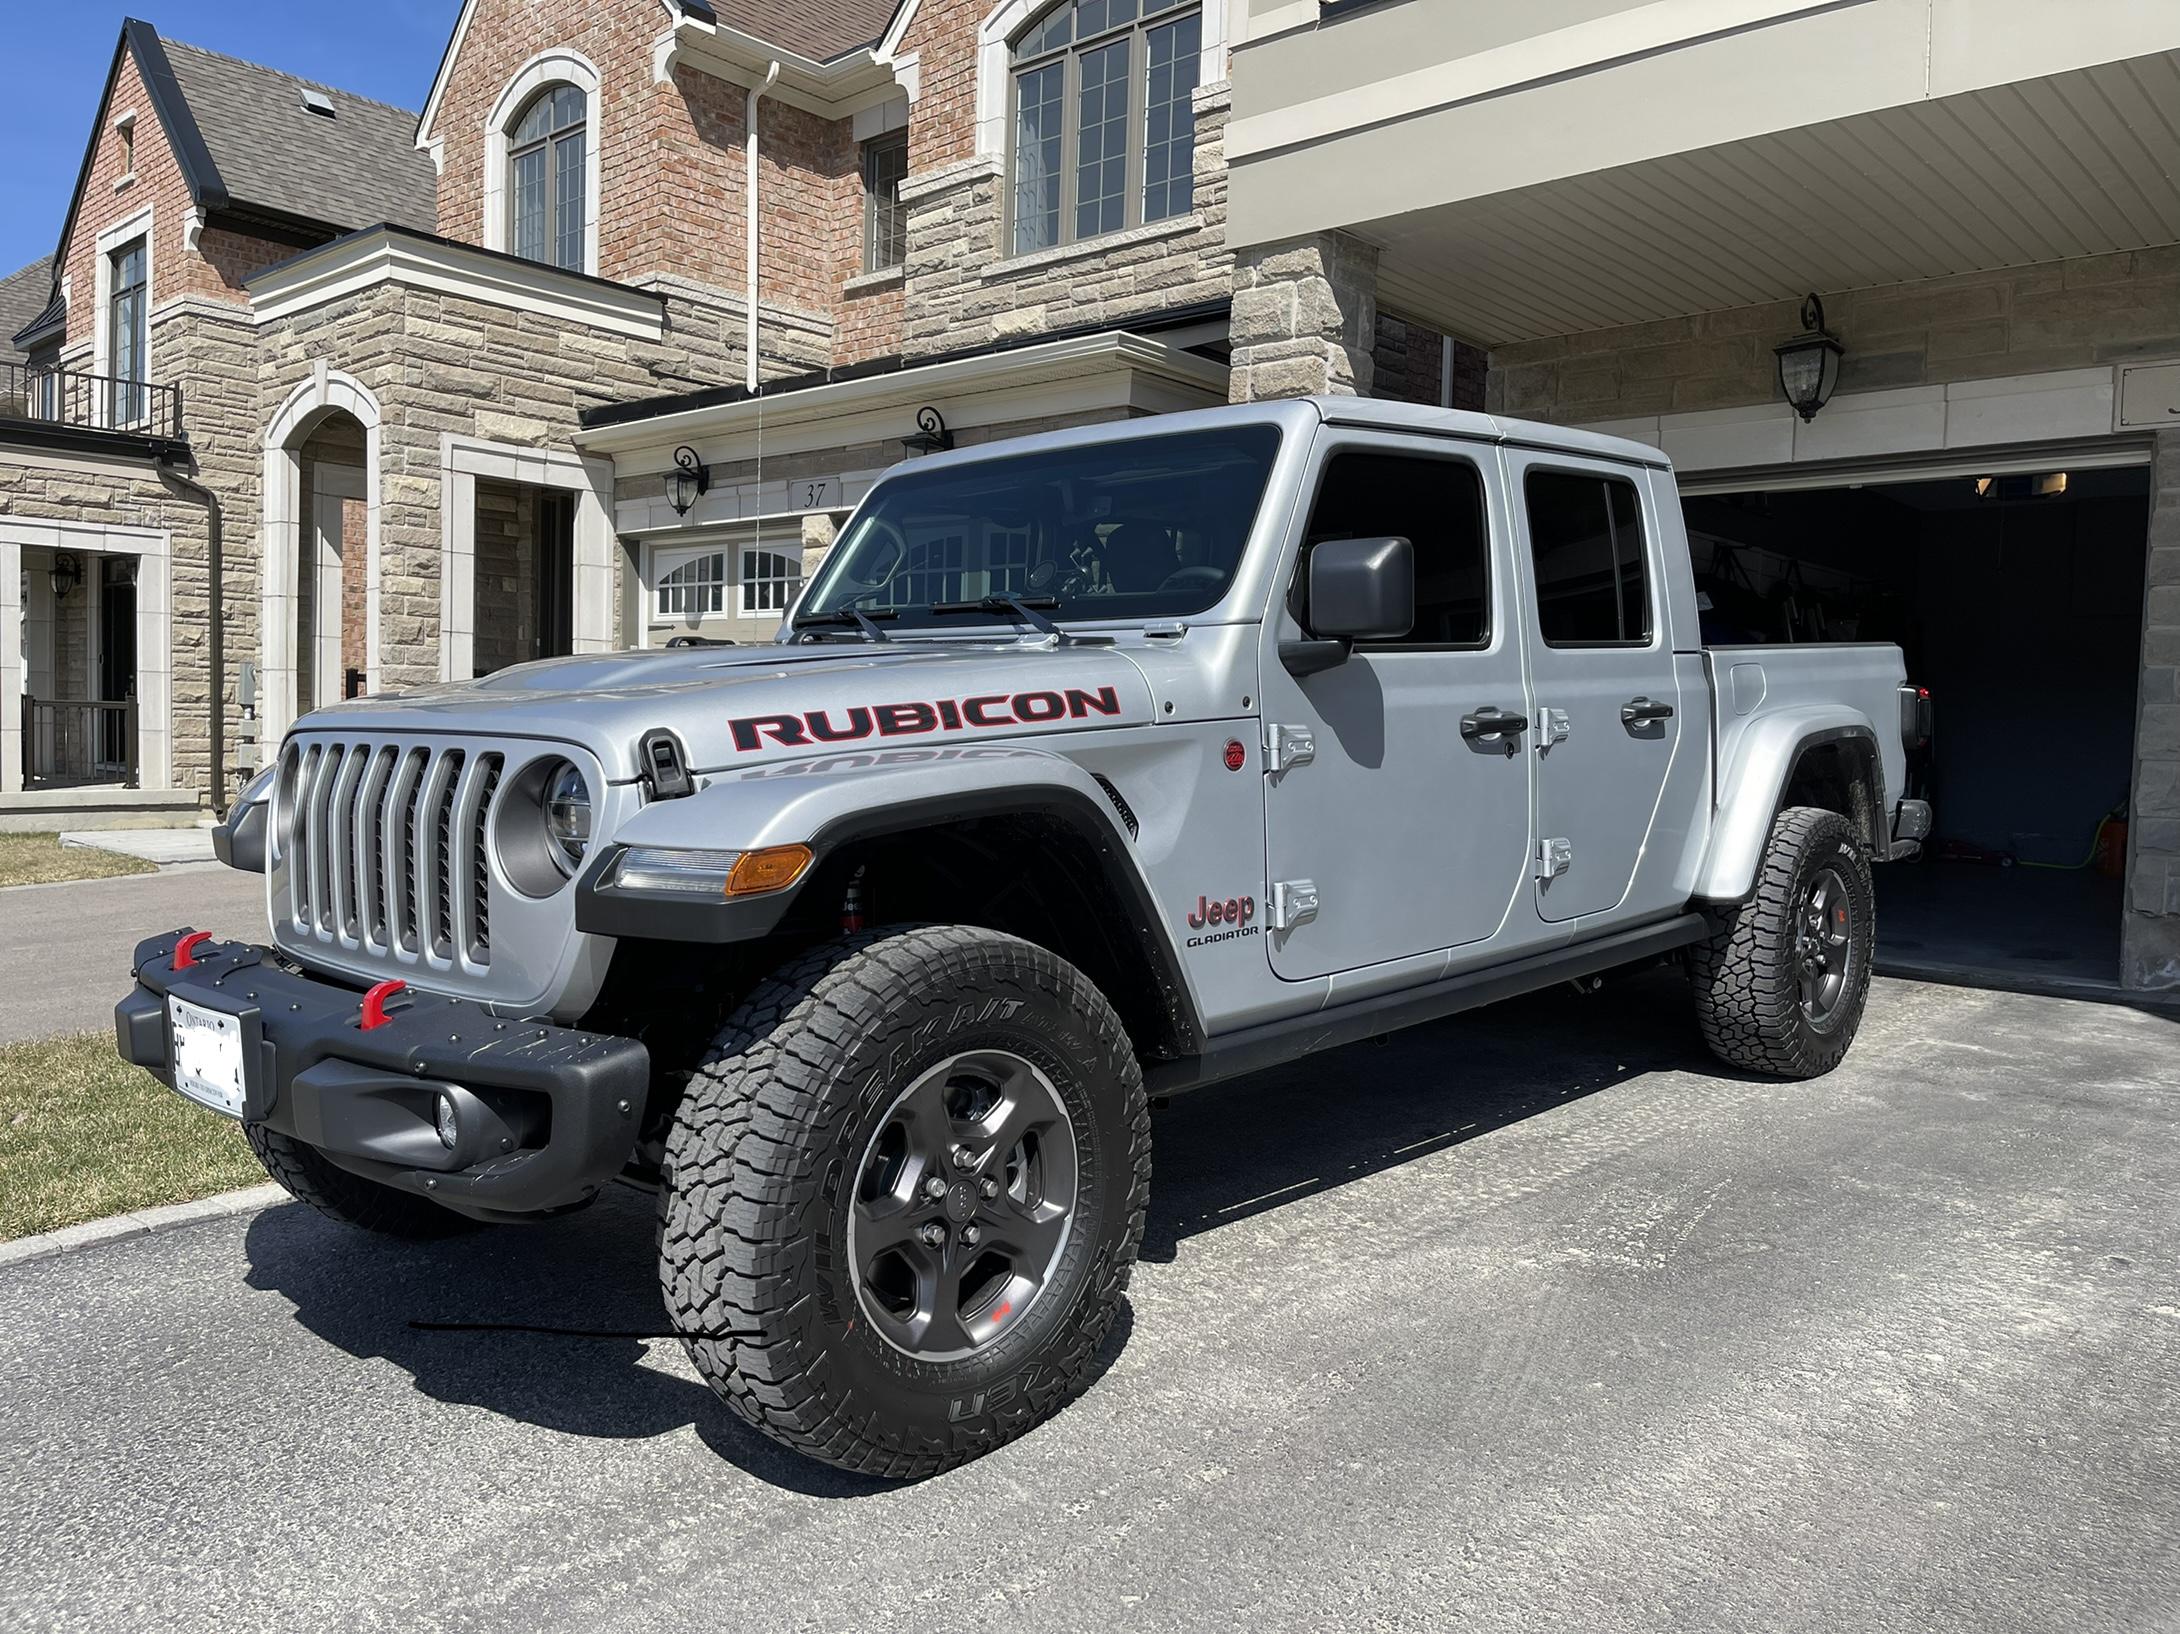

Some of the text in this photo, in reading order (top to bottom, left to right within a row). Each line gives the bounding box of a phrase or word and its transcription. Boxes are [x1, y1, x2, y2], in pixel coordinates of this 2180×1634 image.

[804, 483, 826, 508] 37
[727, 686, 1121, 751] RUBICON
[1187, 895, 1255, 930] Jeep
[1186, 926, 1259, 947] GLADIATOR
[185, 1011, 216, 1032] ONTARIO
